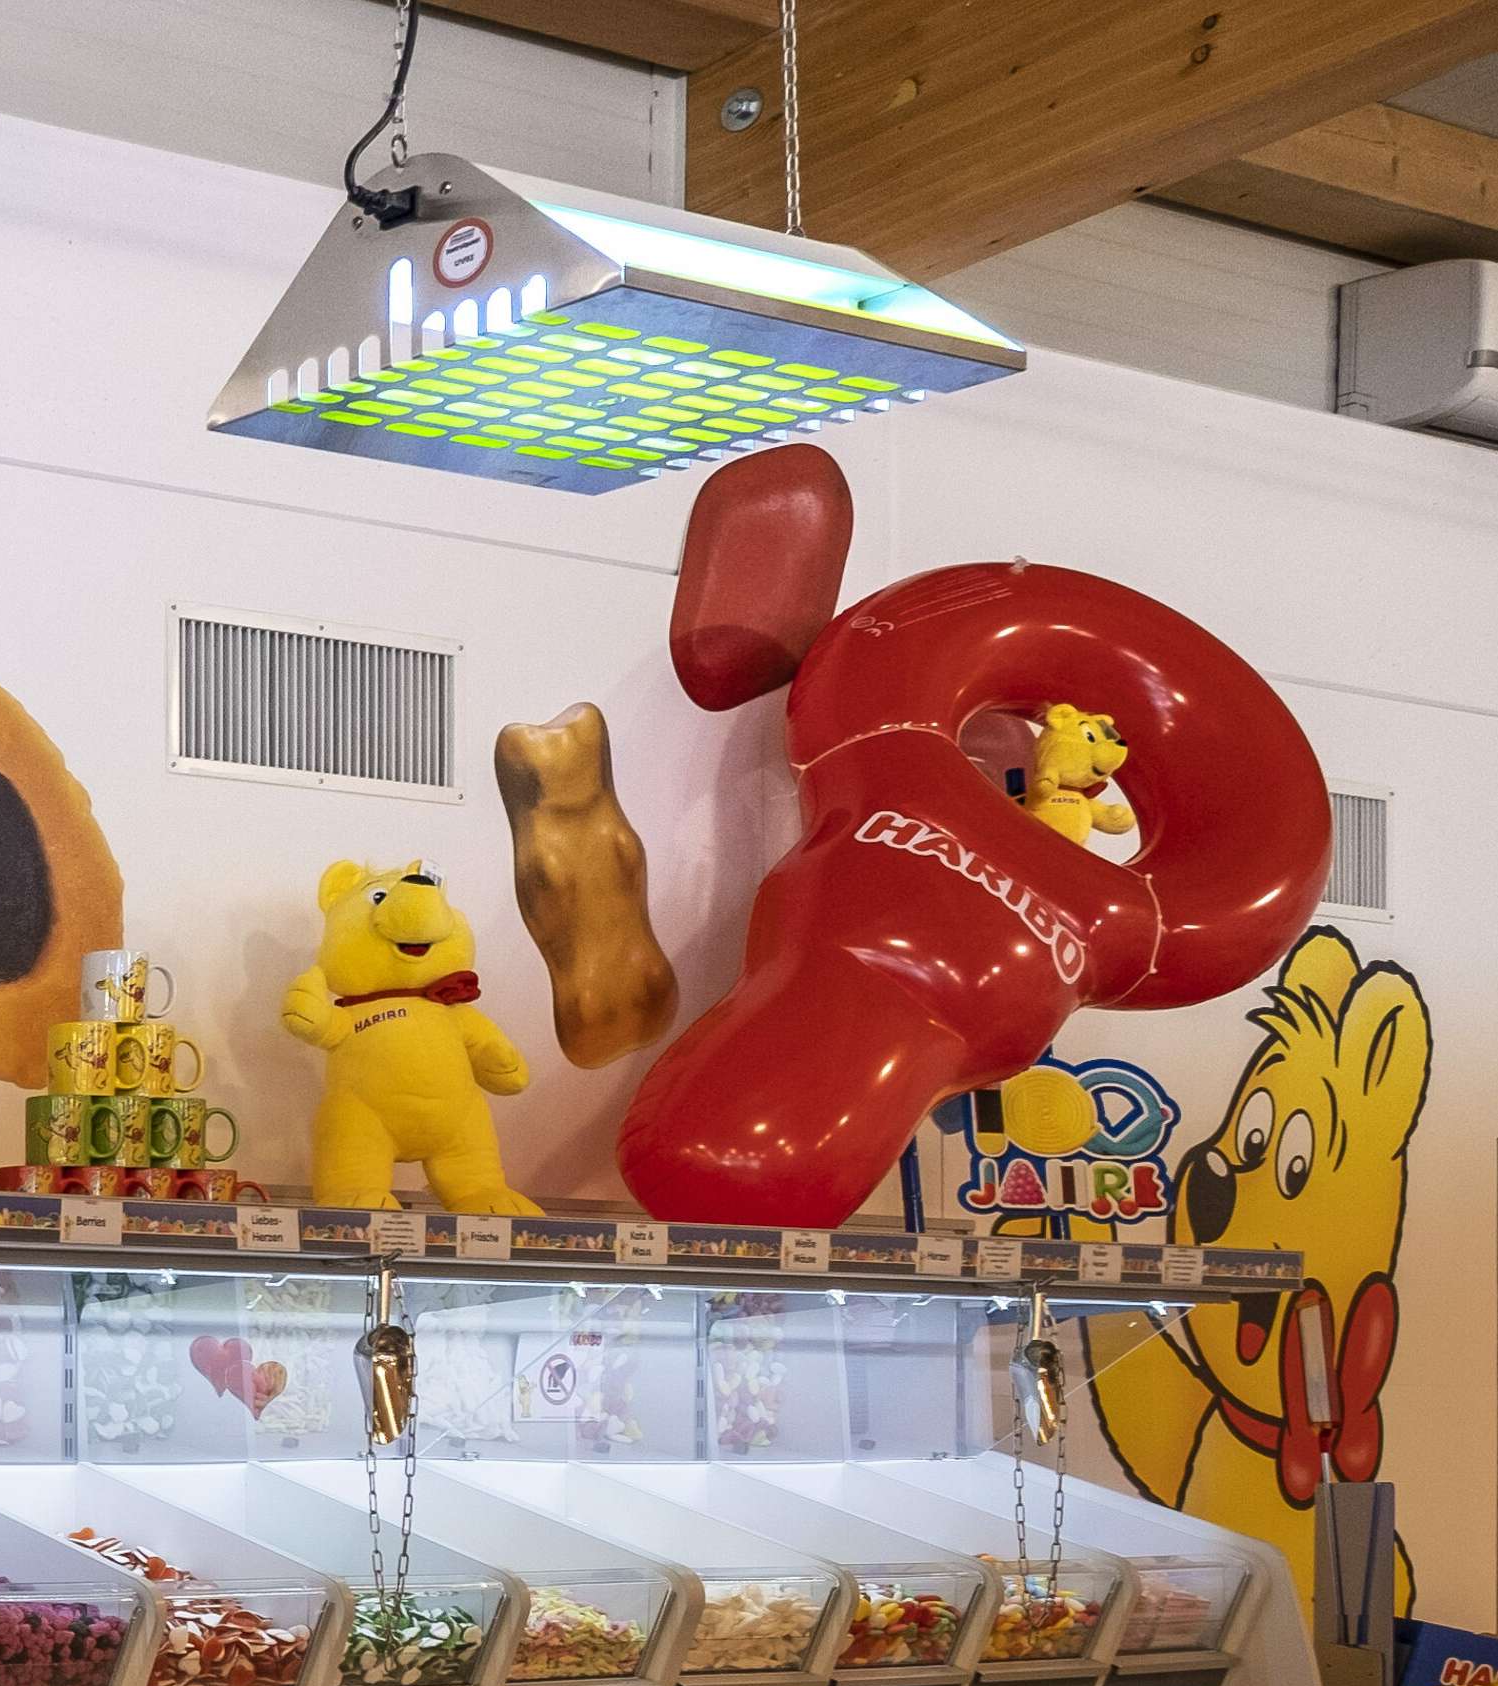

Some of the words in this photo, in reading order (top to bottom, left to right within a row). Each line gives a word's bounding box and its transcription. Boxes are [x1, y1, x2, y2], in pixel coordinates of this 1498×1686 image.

[855, 810, 1085, 984] HARIBO
[354, 1008, 407, 1033] HARIBO
[966, 1158, 1167, 1218] JAHRE
[76, 1216, 106, 1227] Berries
